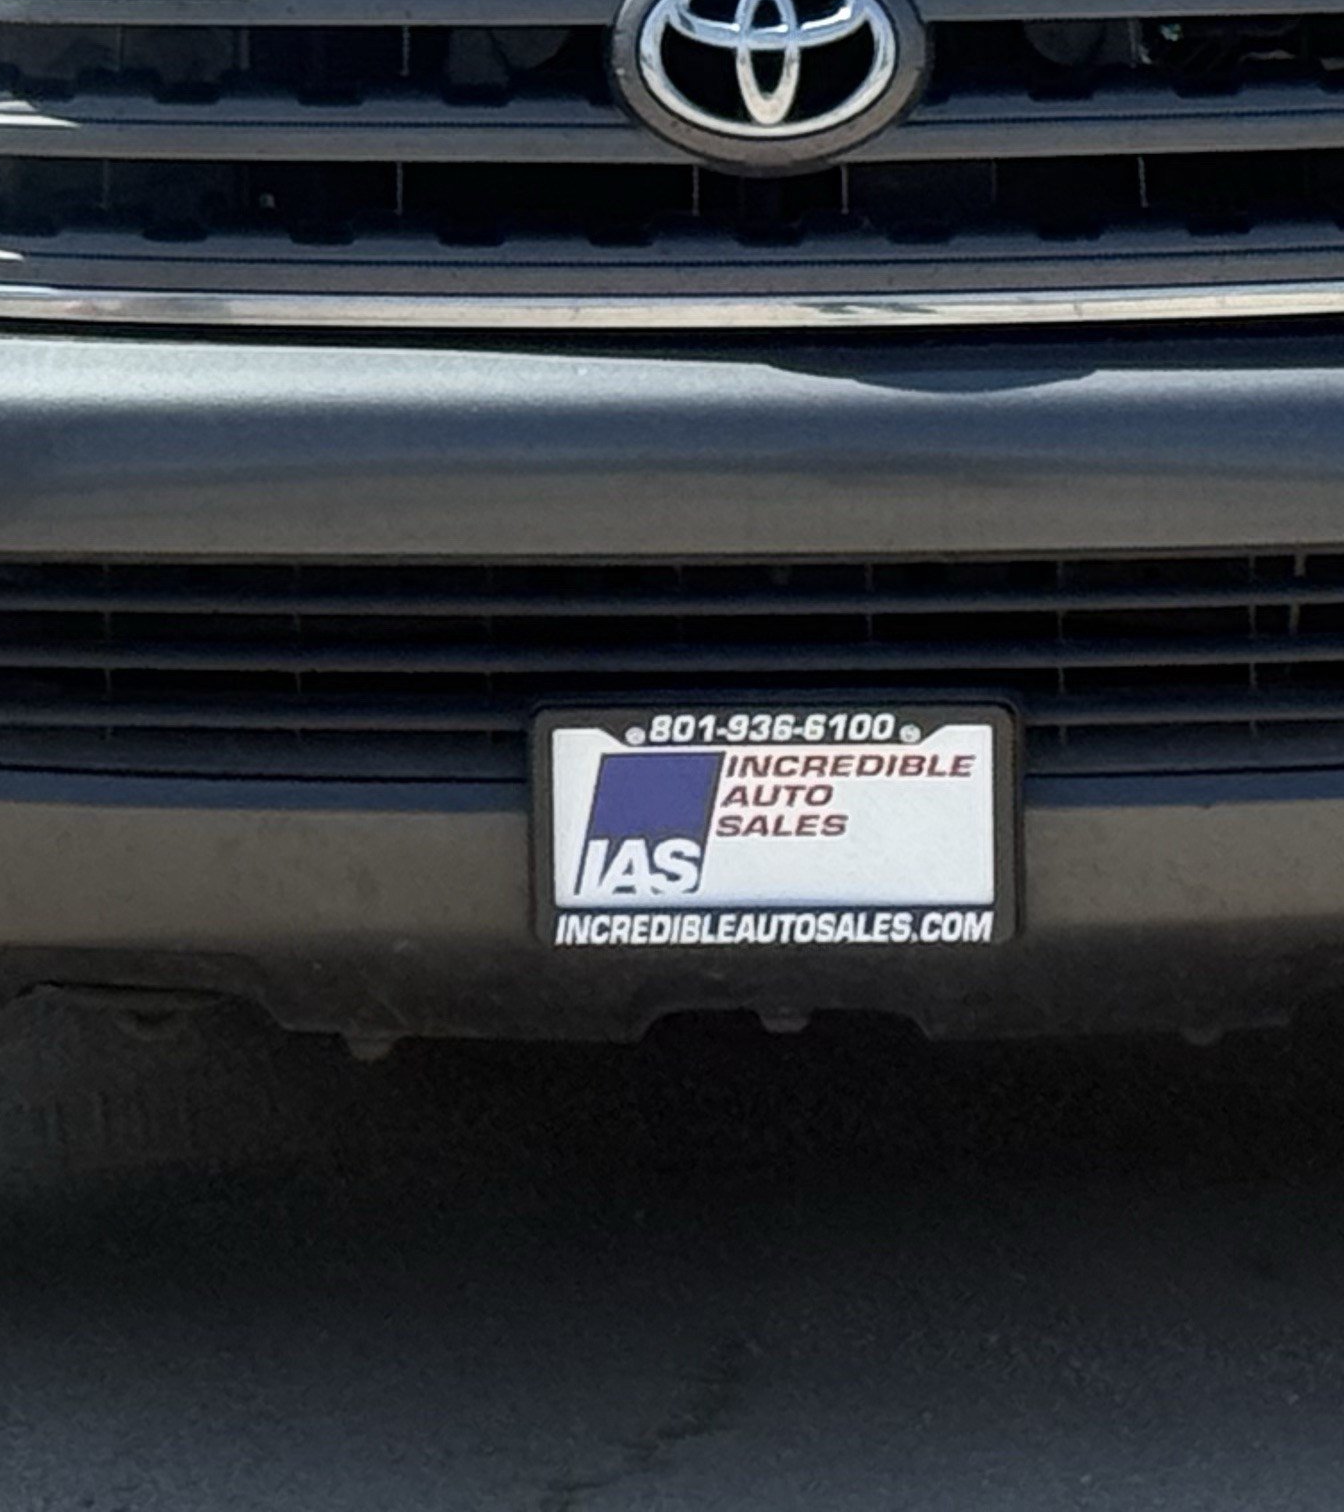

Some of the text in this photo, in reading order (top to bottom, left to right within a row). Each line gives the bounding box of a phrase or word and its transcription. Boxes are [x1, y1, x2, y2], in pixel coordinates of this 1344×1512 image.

[649, 714, 896, 744] 801-936-6100
[725, 753, 977, 779] INCREDIBLE
[720, 783, 835, 808] AUTO
[714, 813, 849, 837] SALES
[578, 838, 702, 894] IAS
[555, 911, 995, 946] INCREDIBLEAUTOSALES.COM
